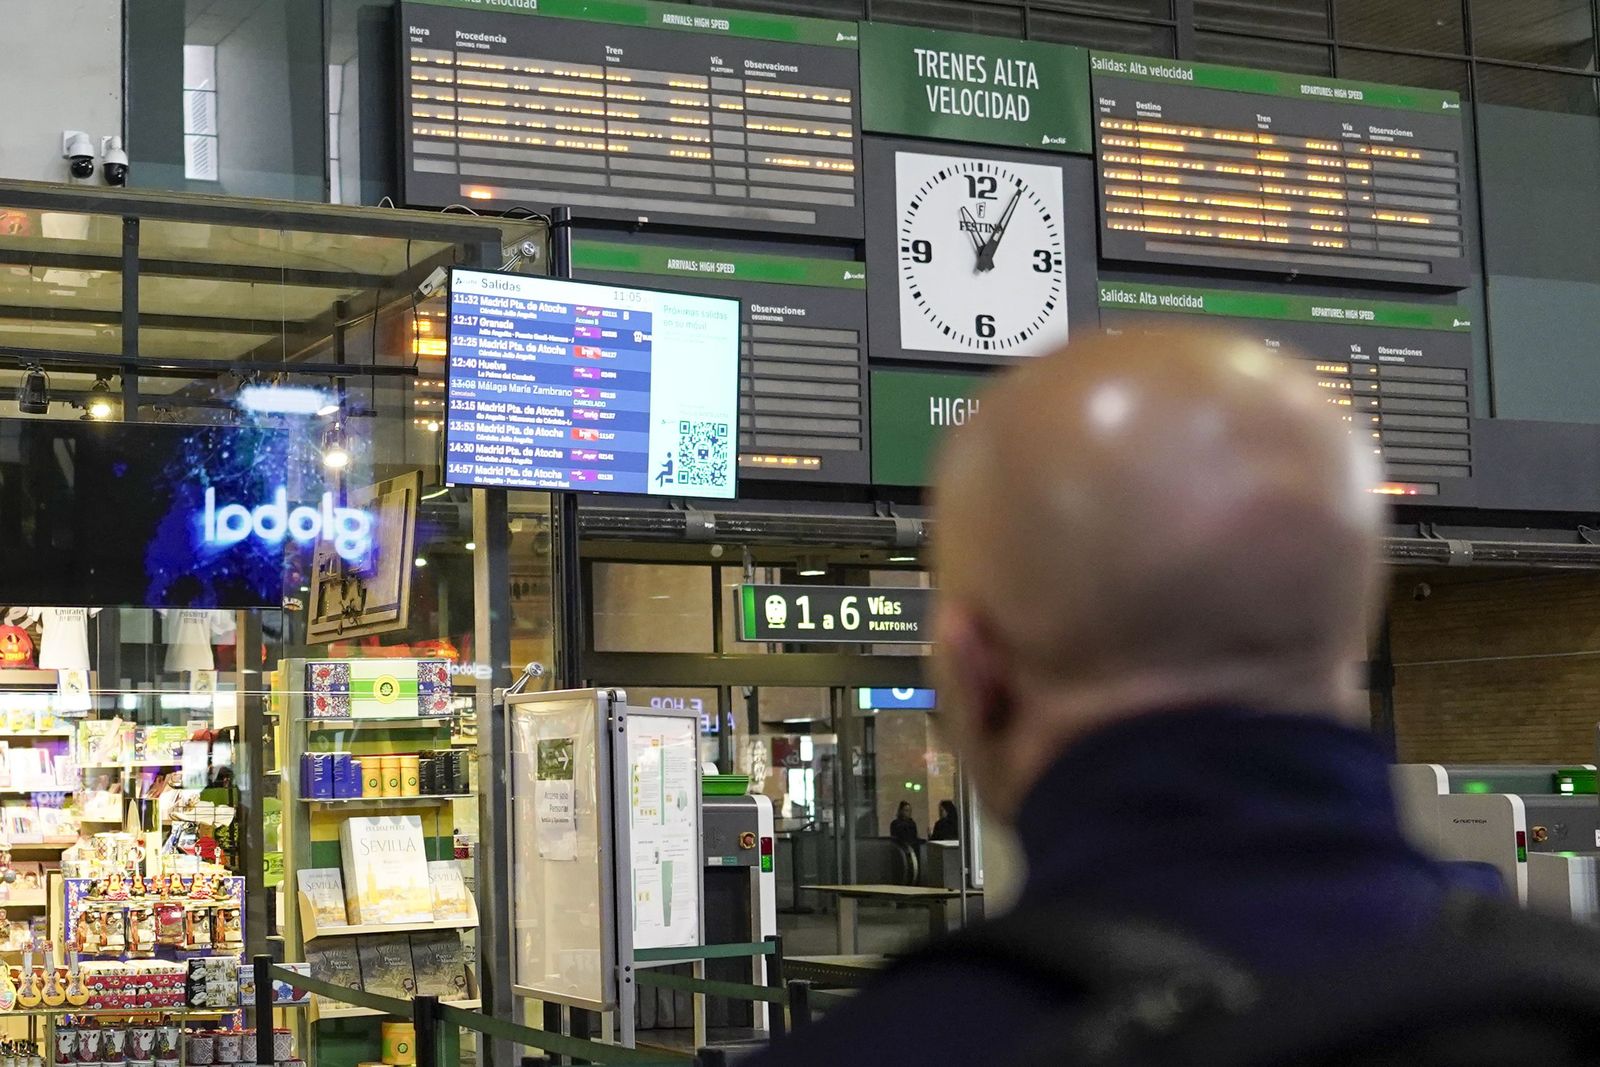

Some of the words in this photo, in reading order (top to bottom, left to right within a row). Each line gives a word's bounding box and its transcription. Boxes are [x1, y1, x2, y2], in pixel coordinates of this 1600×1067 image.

[663, 14, 692, 26] ARRIVALS:
[694, 18, 710, 28] HIGH
[711, 19, 729, 30] SPEED
[410, 26, 430, 36] Hora
[455, 30, 507, 43] Procedencia
[605, 46, 623, 55] Tren
[711, 56, 723, 65] Vía
[744, 60, 798, 72] Observaciones
[914, 49, 986, 83] TRENES
[994, 58, 1039, 90] ALTA
[1092, 57, 1127, 72] Salidas:
[1130, 62, 1147, 74] Alta
[1150, 66, 1193, 80] velocidad
[1301, 85, 1333, 97] DEPARTURES:
[1334, 88, 1347, 99] HIGH
[1348, 90, 1363, 100] SPEED
[926, 84, 1030, 121] VELOCIDAD
[1100, 97, 1116, 106] Hora
[1136, 101, 1161, 111] Destino
[1257, 114, 1271, 123] Tren
[1342, 122, 1353, 131] Vía
[1369, 126, 1413, 137] Observaciones
[964, 175, 998, 200] 12
[912, 239, 932, 264] 9
[668, 259, 698, 271] ARRIVALS:
[700, 262, 715, 272] HIGH
[716, 263, 735, 274] SPEED
[1033, 250, 1052, 273] 3
[481, 278, 521, 291] Salidas
[454, 293, 479, 305] 11:32
[480, 296, 508, 308] Madrid
[510, 299, 525, 310] Pta.
[527, 301, 538, 311] de
[539, 302, 567, 314] Atocha
[1101, 289, 1137, 303] Salidas:
[1140, 292, 1157, 304] Alta
[1160, 294, 1203, 308] velocidad
[751, 304, 806, 316] Observaciones
[1312, 307, 1344, 318] DEPARTURES:
[1345, 309, 1358, 319] HIGH
[1359, 310, 1375, 320] SPEED
[453, 315, 478, 326] 12:17
[480, 317, 514, 330] Granada
[975, 314, 996, 338] 6
[452, 336, 478, 346] 12:25
[479, 338, 508, 350] Madrid
[509, 341, 524, 352] Pta.
[526, 343, 536, 352] de
[538, 344, 566, 355] Atocha
[1351, 344, 1361, 353] Vía
[1378, 346, 1422, 356] Observaciones
[452, 358, 476, 368] 12:40
[478, 360, 506, 371] Huelva
[451, 379, 476, 389] 13:08
[478, 381, 507, 393] Málaga
[509, 383, 531, 393] María
[533, 385, 572, 397] Zambrano
[450, 400, 476, 410] 13:15
[477, 401, 505, 413] Madrid
[507, 404, 523, 414] Pta.
[524, 405, 535, 415] de
[536, 406, 564, 417] Atocha
[573, 399, 606, 407] CANCELADO
[930, 397, 979, 426] HIGH
[450, 421, 475, 432] 13:53
[476, 423, 505, 434] Madrid
[506, 425, 522, 435] Pta.
[523, 426, 534, 436] de
[535, 427, 564, 438] Atocha
[450, 442, 474, 453] 14:30
[476, 444, 504, 455] Madrid
[506, 446, 521, 456] Pta.
[523, 448, 533, 457] de
[535, 448, 563, 459] Atocha
[449, 464, 473, 474] 14:57
[475, 465, 503, 476] Madrid
[505, 467, 520, 477] Pta.
[522, 469, 532, 478] de
[534, 469, 562, 479] Atocha
[796, 596, 815, 630] 1
[823, 614, 834, 630] a
[841, 596, 860, 630] 6
[868, 596, 901, 615] Vías
[869, 622, 918, 631] PLATFORMS
[360, 836, 416, 856] SEVILLA
[305, 879, 340, 892] SEVILLA
